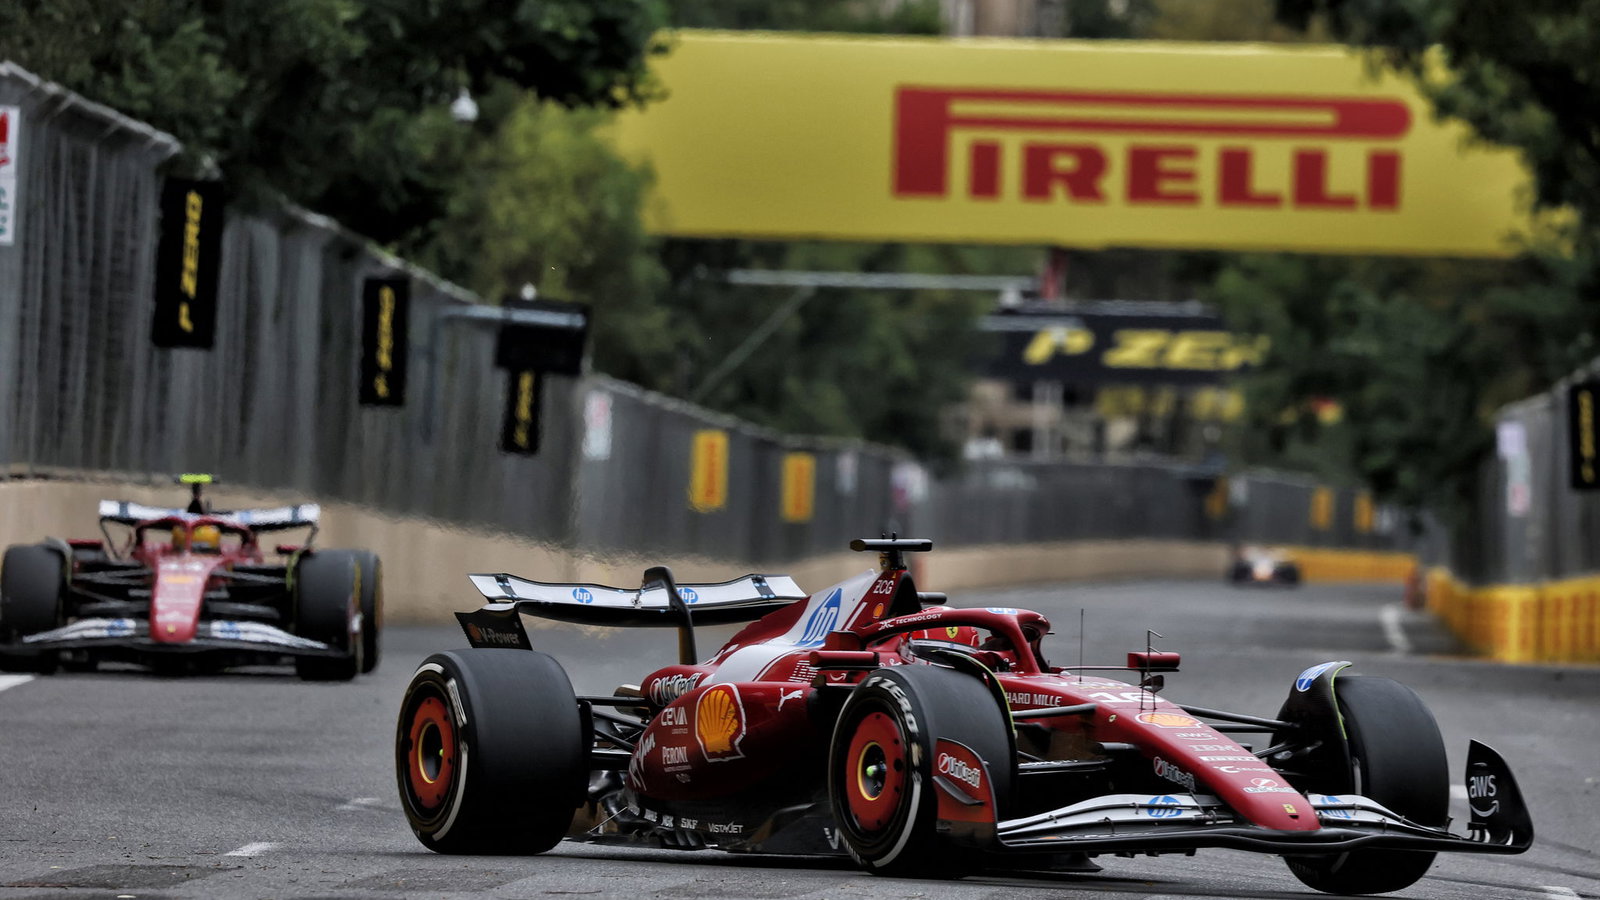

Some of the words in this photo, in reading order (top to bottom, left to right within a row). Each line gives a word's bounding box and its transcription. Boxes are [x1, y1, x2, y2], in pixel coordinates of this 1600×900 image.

[893, 84, 1412, 212] PIRELLI
[873, 579, 894, 595] ZCG
[574, 588, 593, 604] hp
[681, 588, 698, 604] hp
[896, 613, 942, 625] TECHNOLOGY
[478, 627, 520, 645] V-Power
[866, 677, 883, 687] P
[878, 678, 919, 733] ZERO
[1005, 691, 1031, 705] HARD
[1033, 693, 1062, 707] MILLE
[1088, 691, 1165, 703] 16
[662, 746, 689, 765] PERONI
[1469, 774, 1497, 798] aws
[680, 817, 698, 830] SKF
